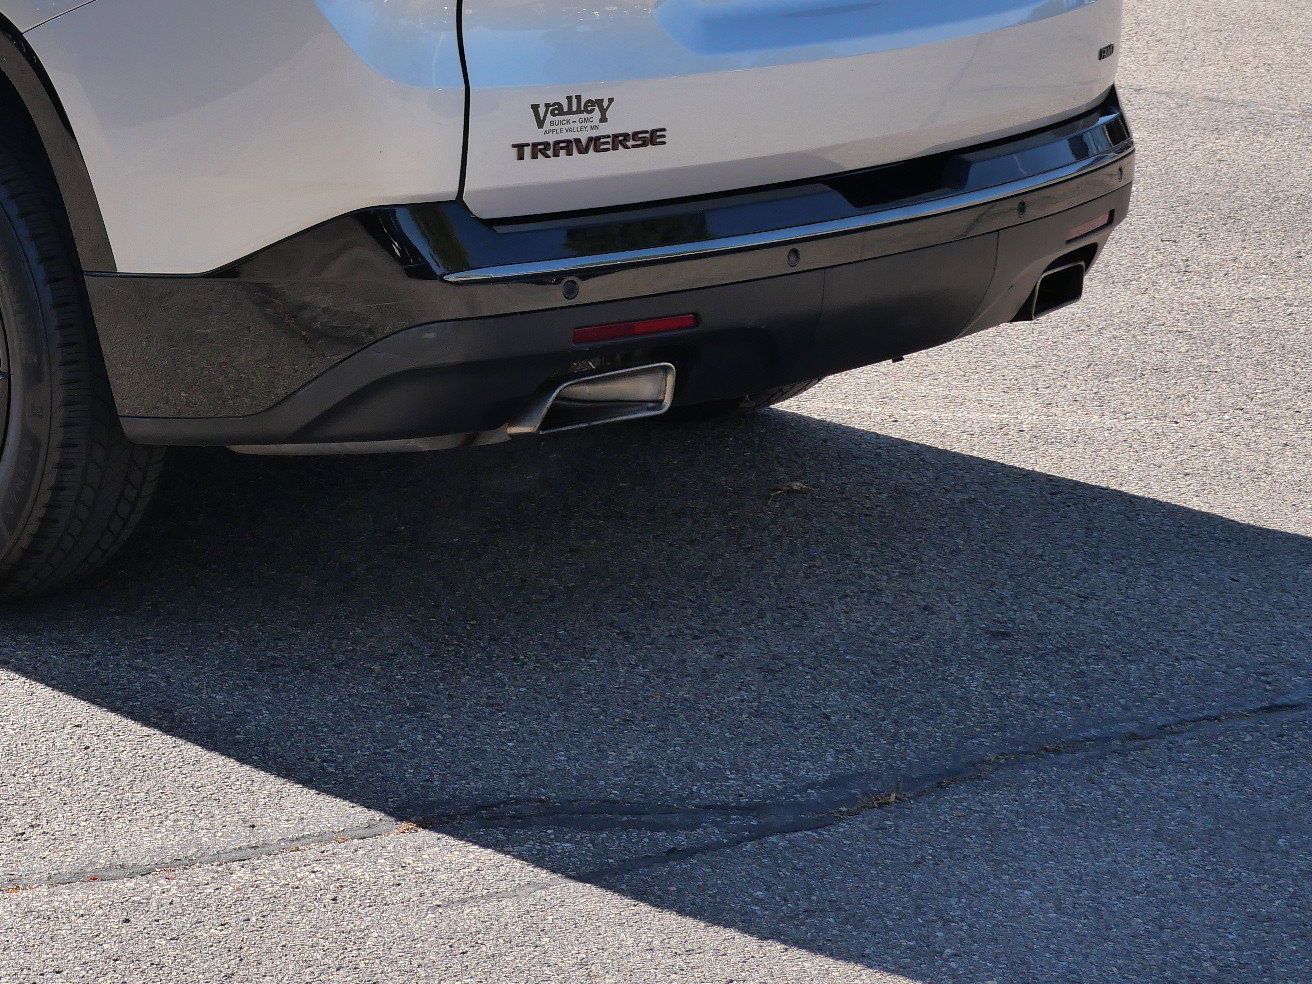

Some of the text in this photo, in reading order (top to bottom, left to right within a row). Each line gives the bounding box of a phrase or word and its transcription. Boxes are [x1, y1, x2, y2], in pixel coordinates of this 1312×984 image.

[549, 118, 571, 127] BUICK
[578, 116, 594, 124] GMC
[543, 127, 564, 136] APPLE
[590, 124, 600, 132] MN
[511, 127, 667, 161] TRAVERSE
